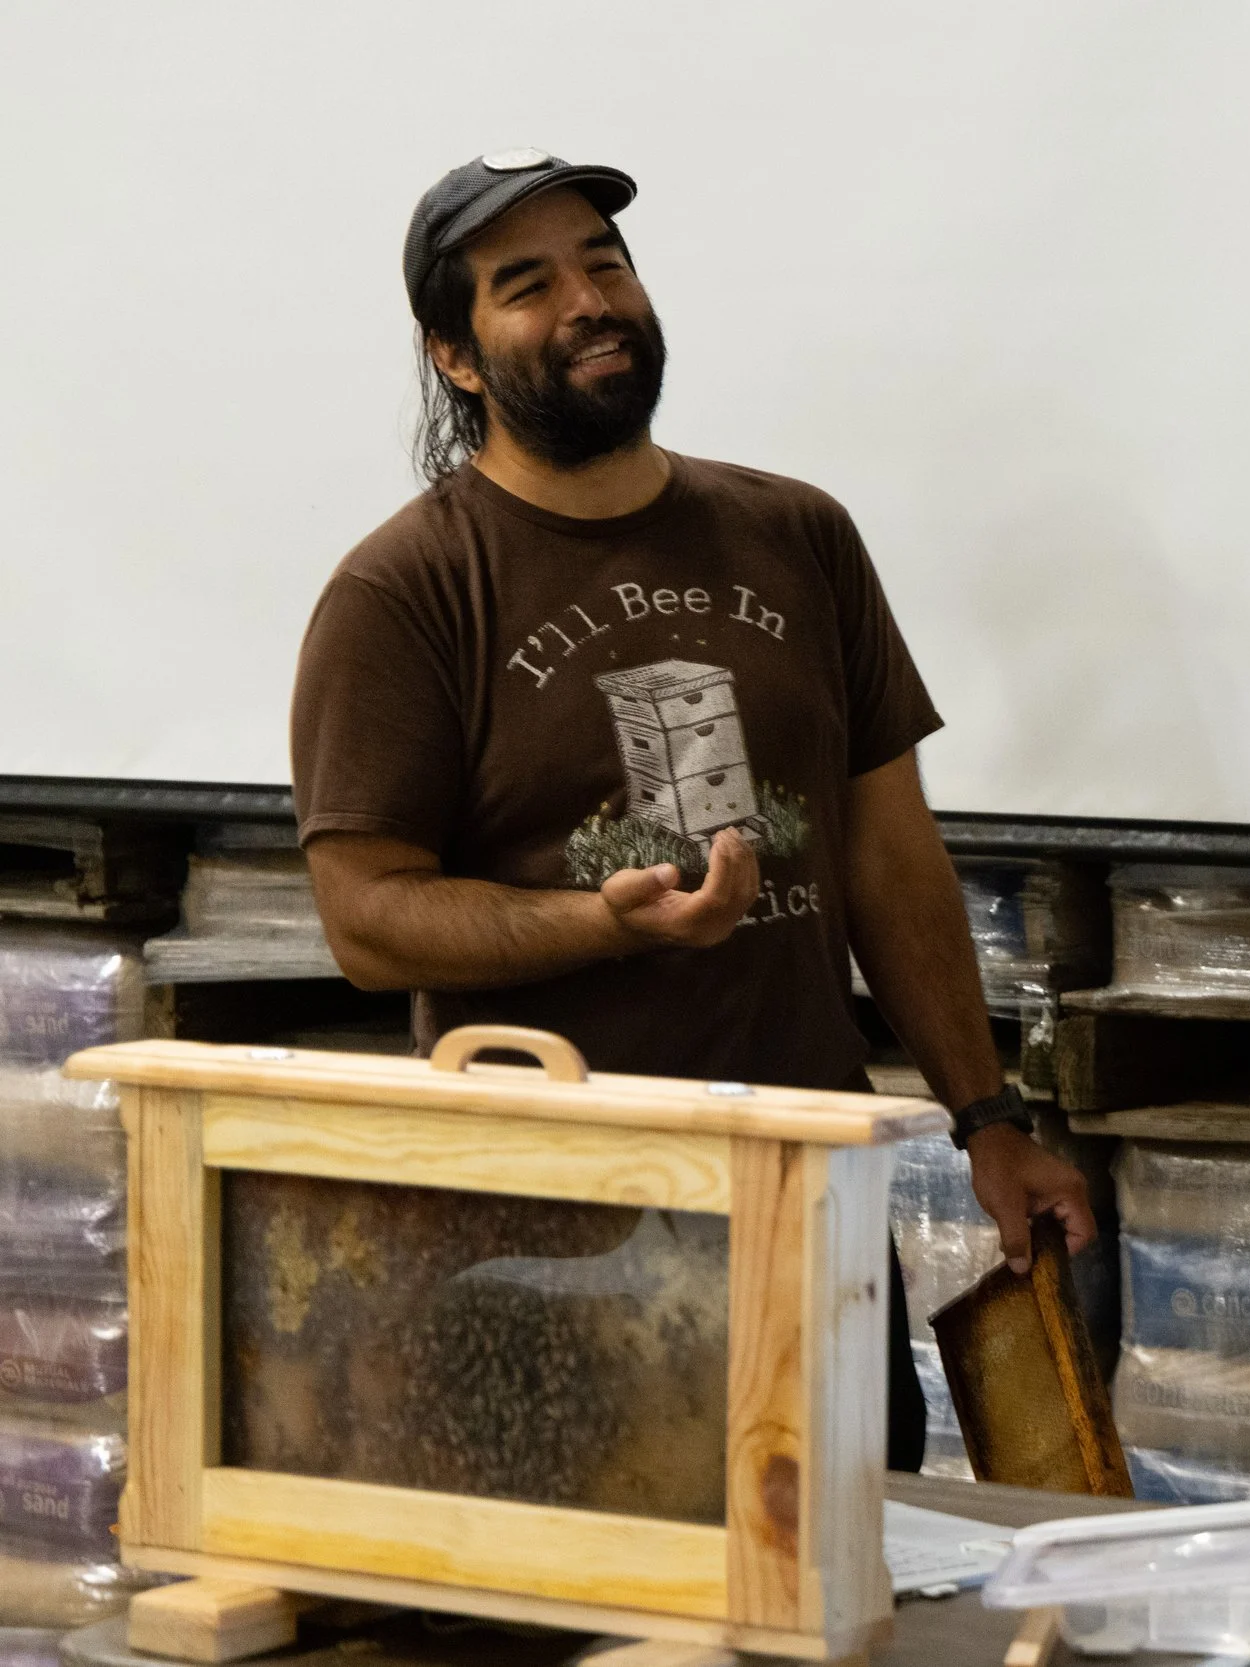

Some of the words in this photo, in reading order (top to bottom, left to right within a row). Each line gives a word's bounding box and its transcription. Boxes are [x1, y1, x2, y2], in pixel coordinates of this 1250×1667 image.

[506, 604, 610, 690] I'll
[611, 581, 711, 621] Bee
[730, 584, 787, 641] In
[22, 1492, 69, 1519] sand
